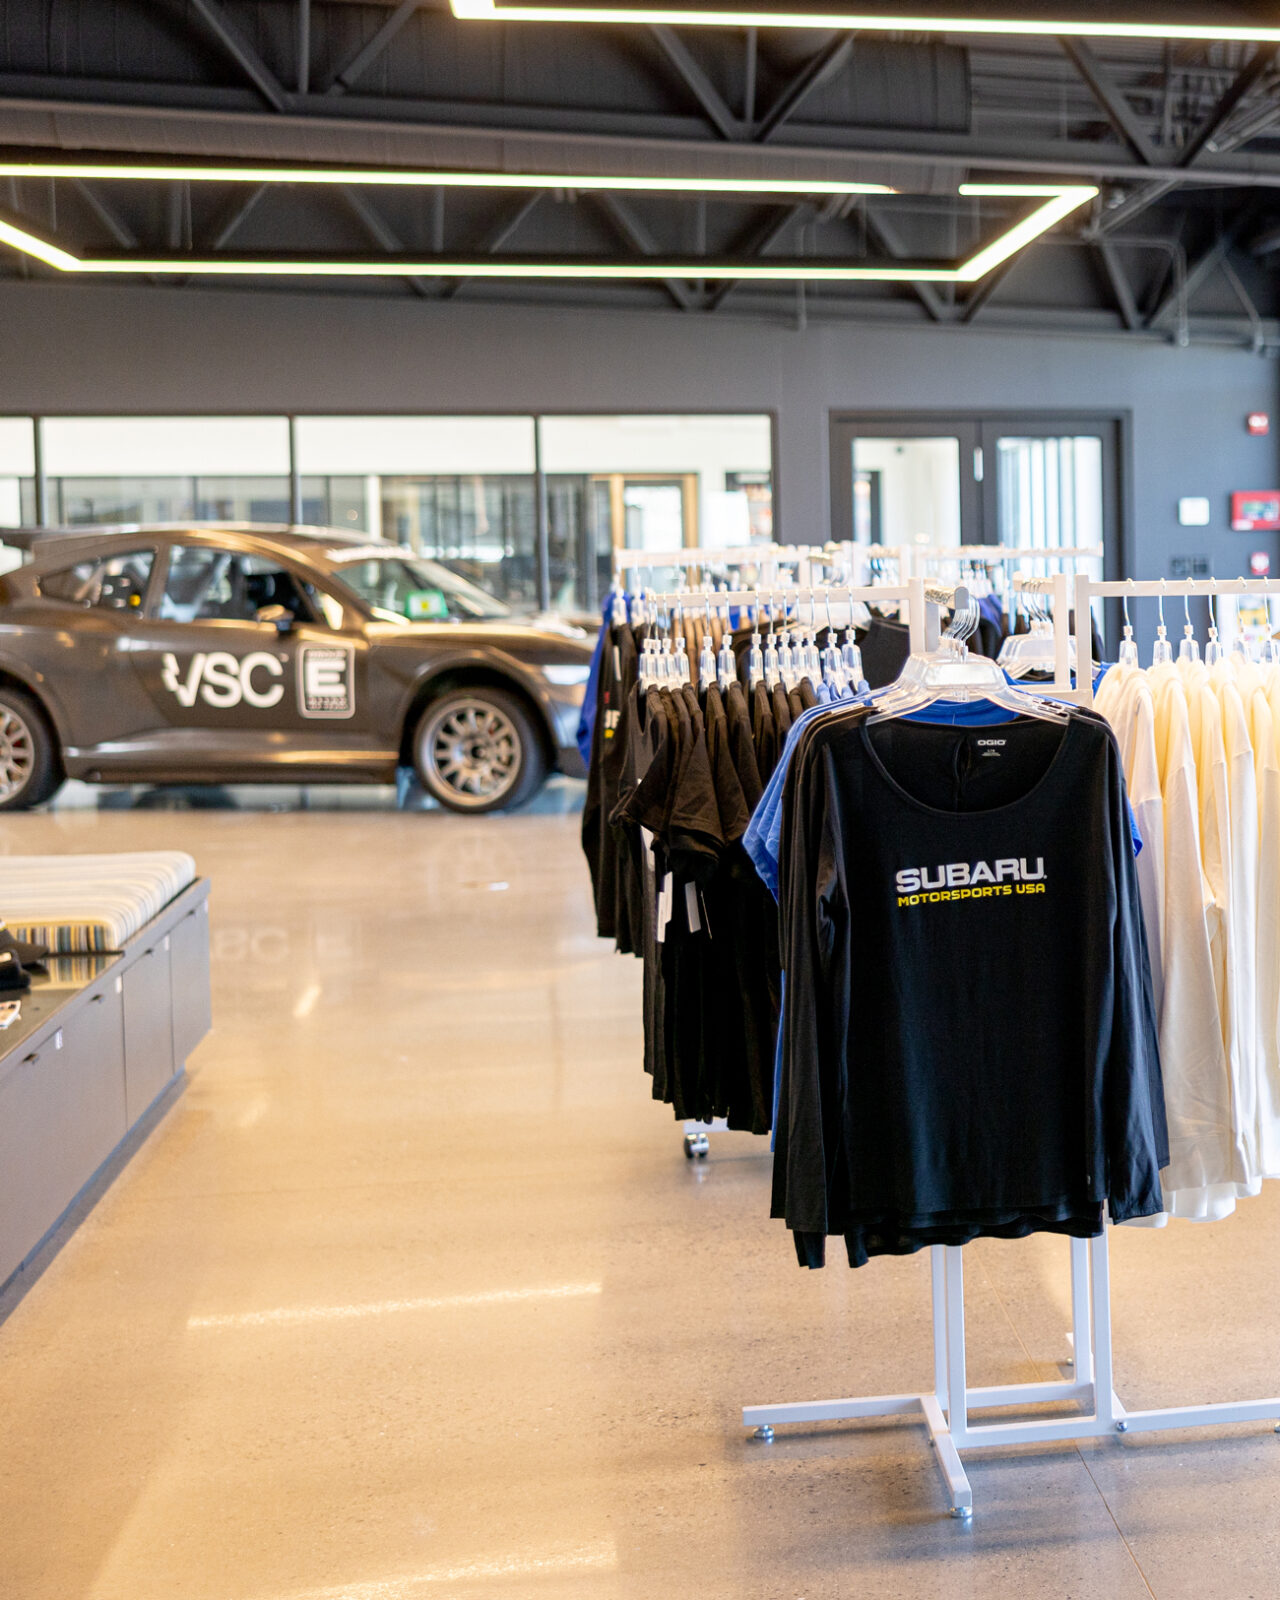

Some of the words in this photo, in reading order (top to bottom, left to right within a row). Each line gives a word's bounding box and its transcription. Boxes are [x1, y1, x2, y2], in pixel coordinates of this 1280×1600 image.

[162, 651, 285, 708] VSC
[305, 659, 346, 697] E
[895, 857, 1046, 893] SUBARU
[897, 884, 1013, 907] MOTORSPORTS
[1016, 883, 1046, 894] USA
